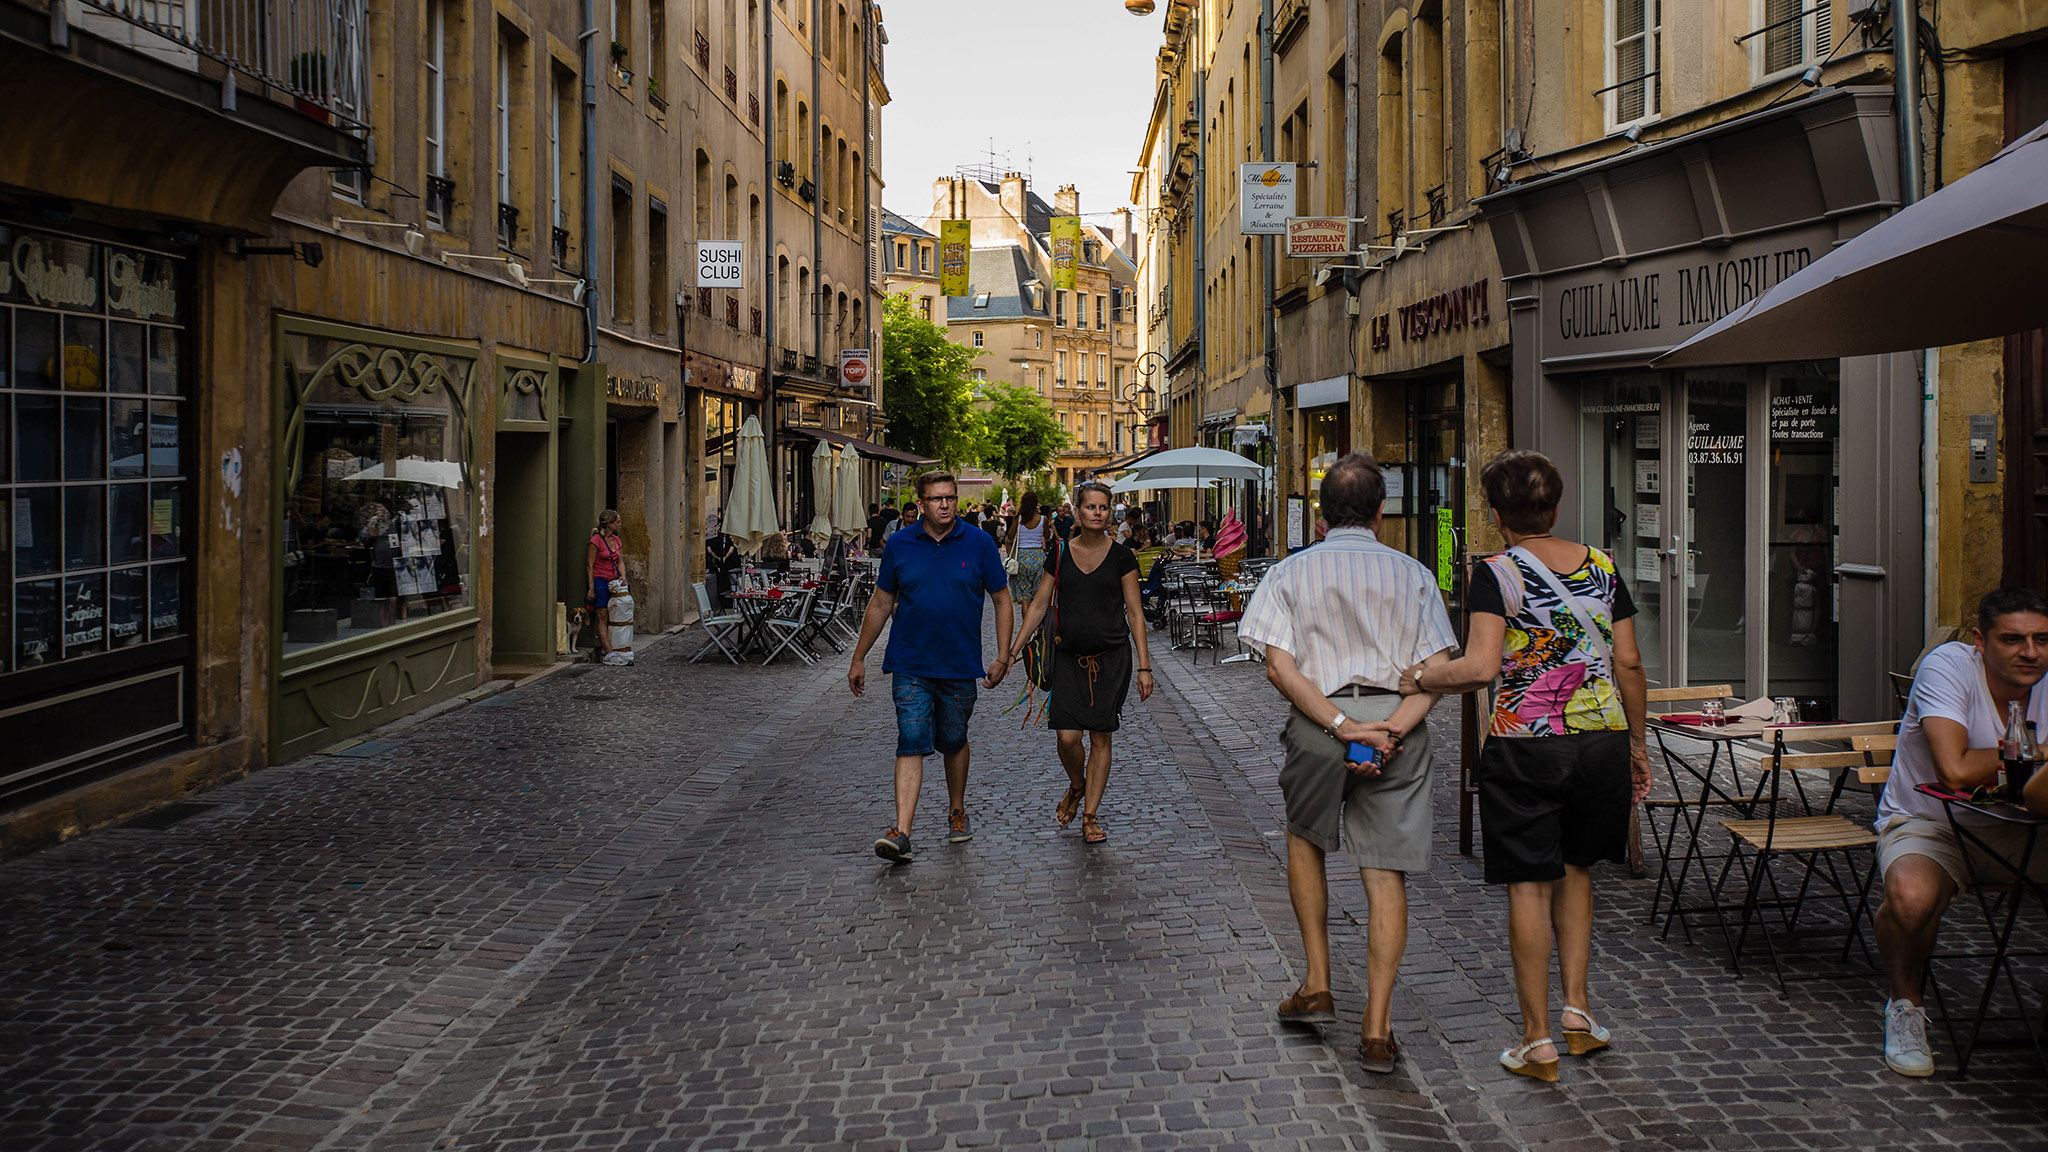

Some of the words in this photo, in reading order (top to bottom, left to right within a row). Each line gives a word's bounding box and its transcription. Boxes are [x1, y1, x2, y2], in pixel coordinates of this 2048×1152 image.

[1251, 191, 1287, 203] Spécialités
[1254, 202, 1284, 210] Lorraine
[1292, 224, 1303, 232] LE
[1307, 222, 1344, 231] VISCONTI
[1291, 234, 1345, 243] RESTAURANT
[1291, 243, 1346, 252] PIZZERIA
[699, 249, 742, 263] SUSHI
[700, 265, 740, 280] CLUB
[1559, 273, 1661, 340] GUILLAUME
[1371, 313, 1390, 351] LE
[1397, 278, 1490, 342] VISCONTI
[1772, 396, 1791, 405] ACHAT
[1795, 394, 1813, 405] VENTE
[1771, 407, 1800, 419] Spécialiste
[1801, 408, 1809, 416] en
[1829, 404, 1838, 415] de
[1688, 421, 1711, 434] Agence
[1771, 419, 1778, 427] et
[1779, 420, 1789, 430] pas
[1791, 418, 1799, 427] de
[1800, 418, 1816, 430] porte
[1771, 429, 1789, 438] Toutes
[1791, 429, 1824, 439] transactions
[1688, 435, 1745, 450] GUILLAUME
[1688, 452, 1743, 464] 03.87.36.16.91
